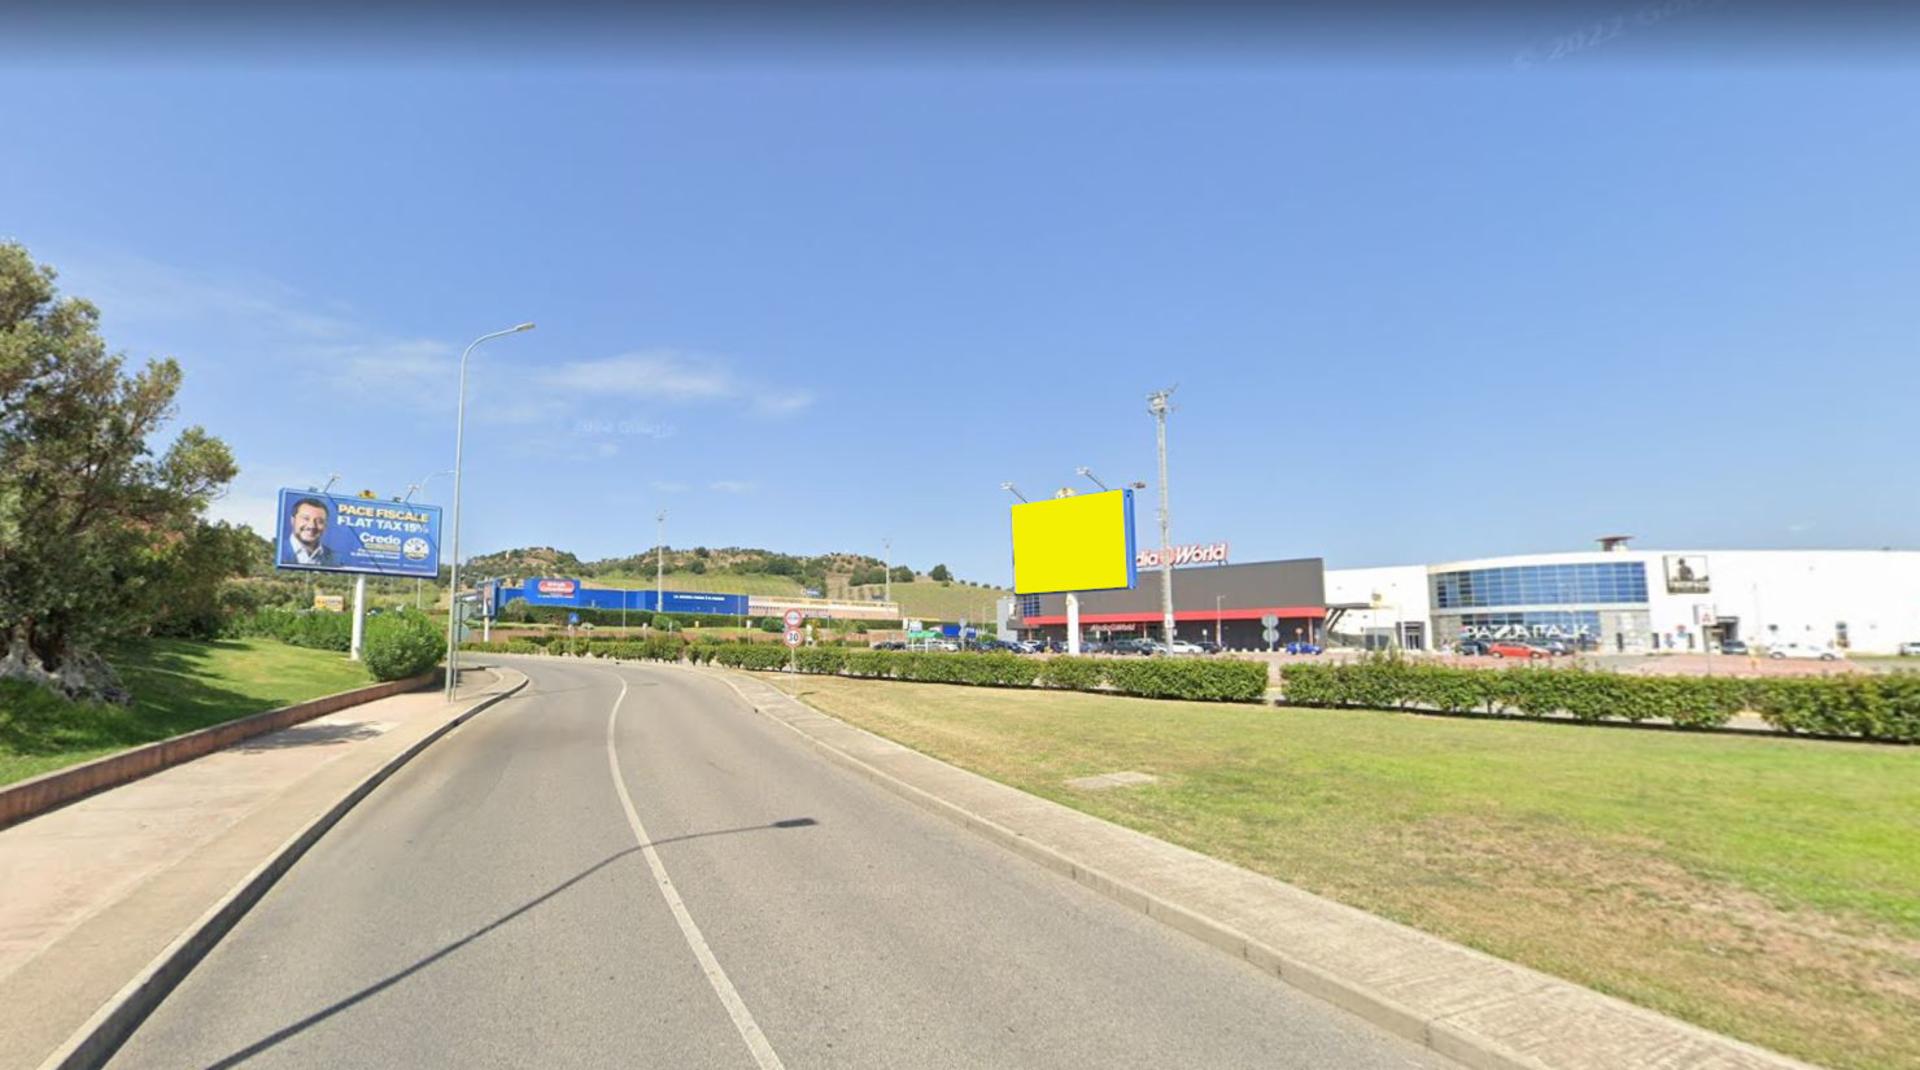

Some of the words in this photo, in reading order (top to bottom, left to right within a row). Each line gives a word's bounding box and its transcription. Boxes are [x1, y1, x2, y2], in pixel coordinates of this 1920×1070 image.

[338, 504, 374, 516] PACE
[376, 508, 429, 522] FISCALE
[337, 515, 373, 527] FLAT
[376, 519, 402, 531] TAX
[360, 532, 401, 544] Credo
[1174, 544, 1226, 565] World
[788, 633, 799, 642] 30
